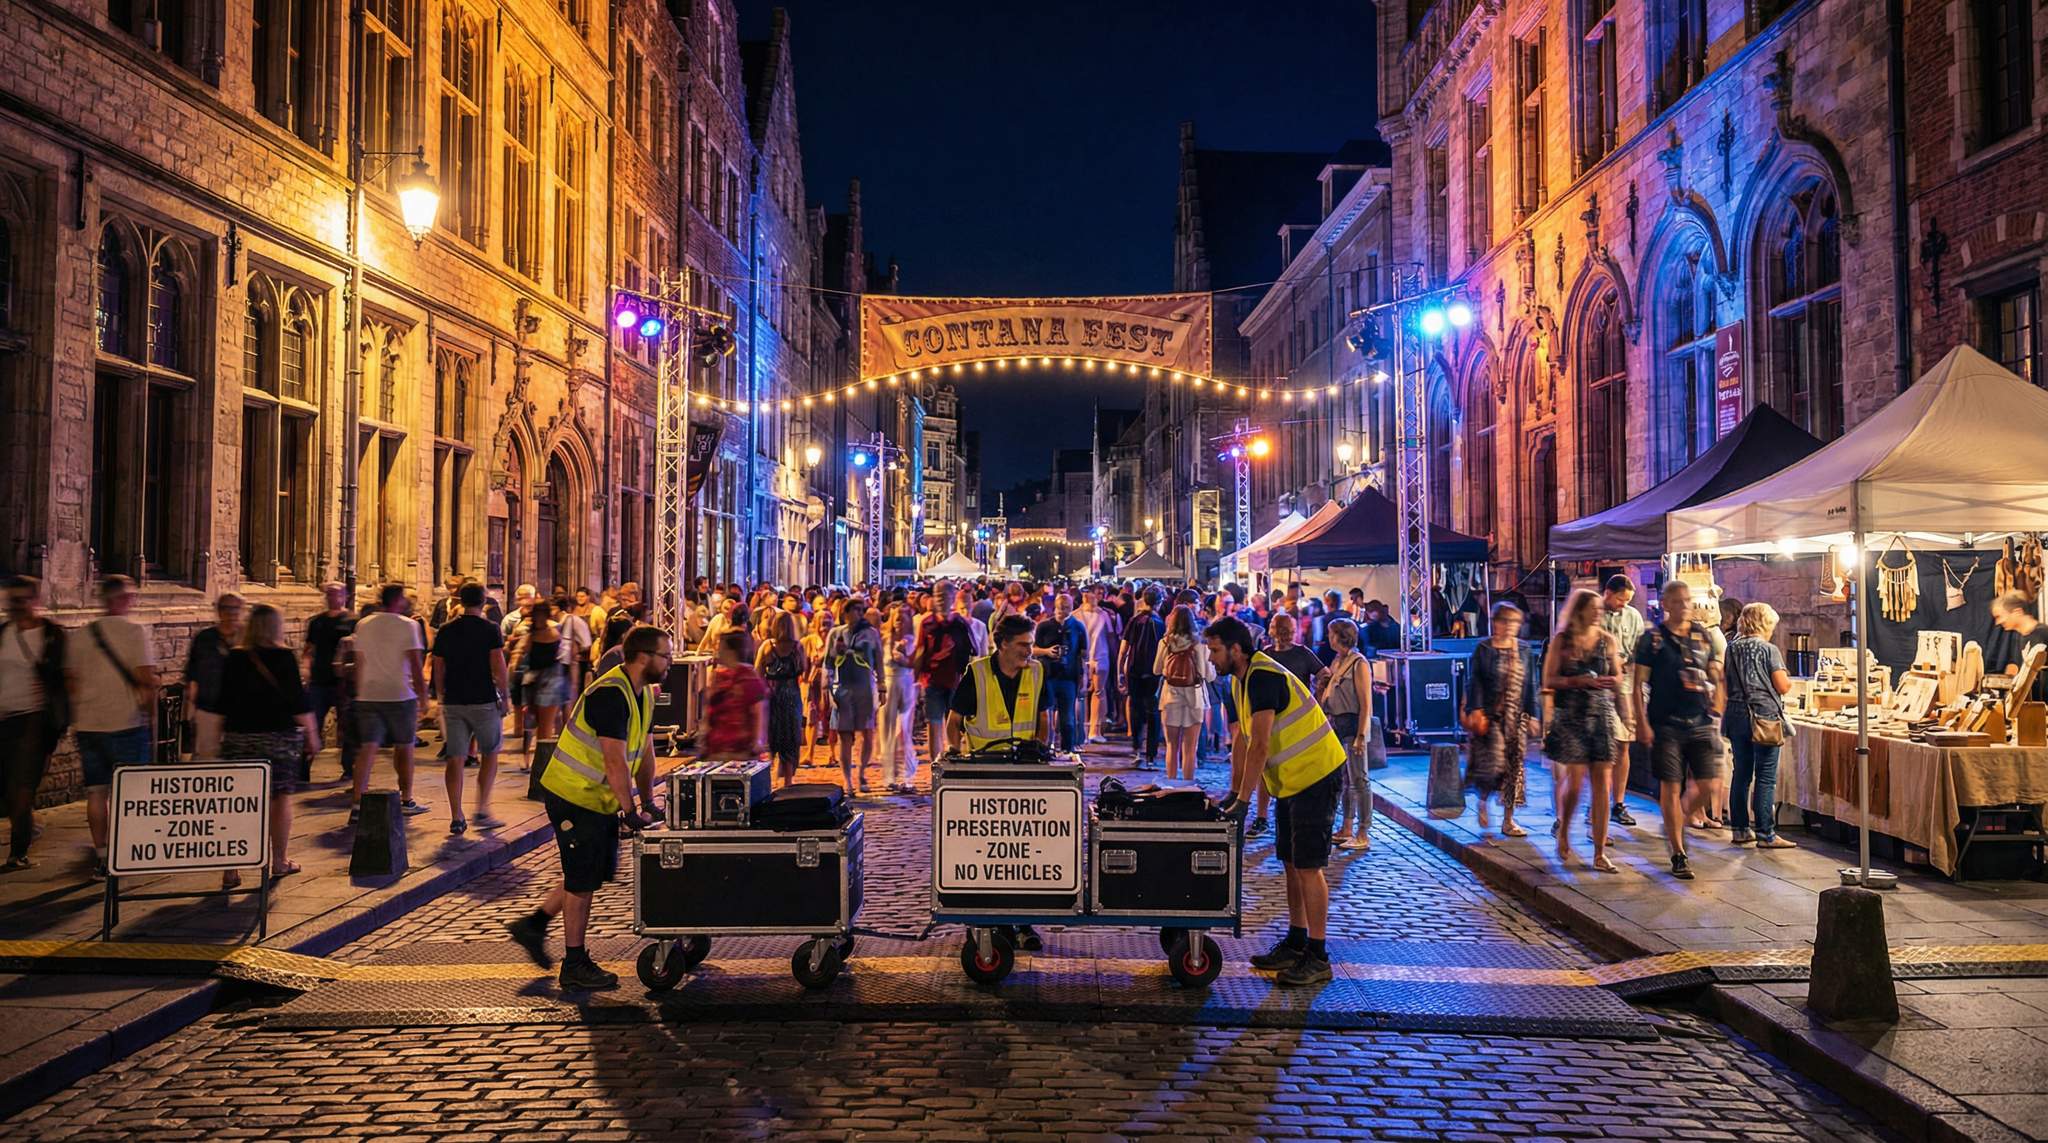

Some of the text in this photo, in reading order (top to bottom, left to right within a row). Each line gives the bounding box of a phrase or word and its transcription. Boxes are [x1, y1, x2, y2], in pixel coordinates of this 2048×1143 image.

[903, 317, 1173, 357] CONTANA FEST
[151, 776, 234, 794] HISTORIC
[124, 797, 258, 817] PRESERVATION
[969, 798, 1047, 815] HISTORIC
[167, 820, 214, 837] ZONE
[946, 820, 1070, 837] PRESERVATION
[131, 840, 248, 861] NO VEHICLES
[987, 842, 1030, 858] ZONE
[954, 864, 1062, 881] NO VEHICLES
